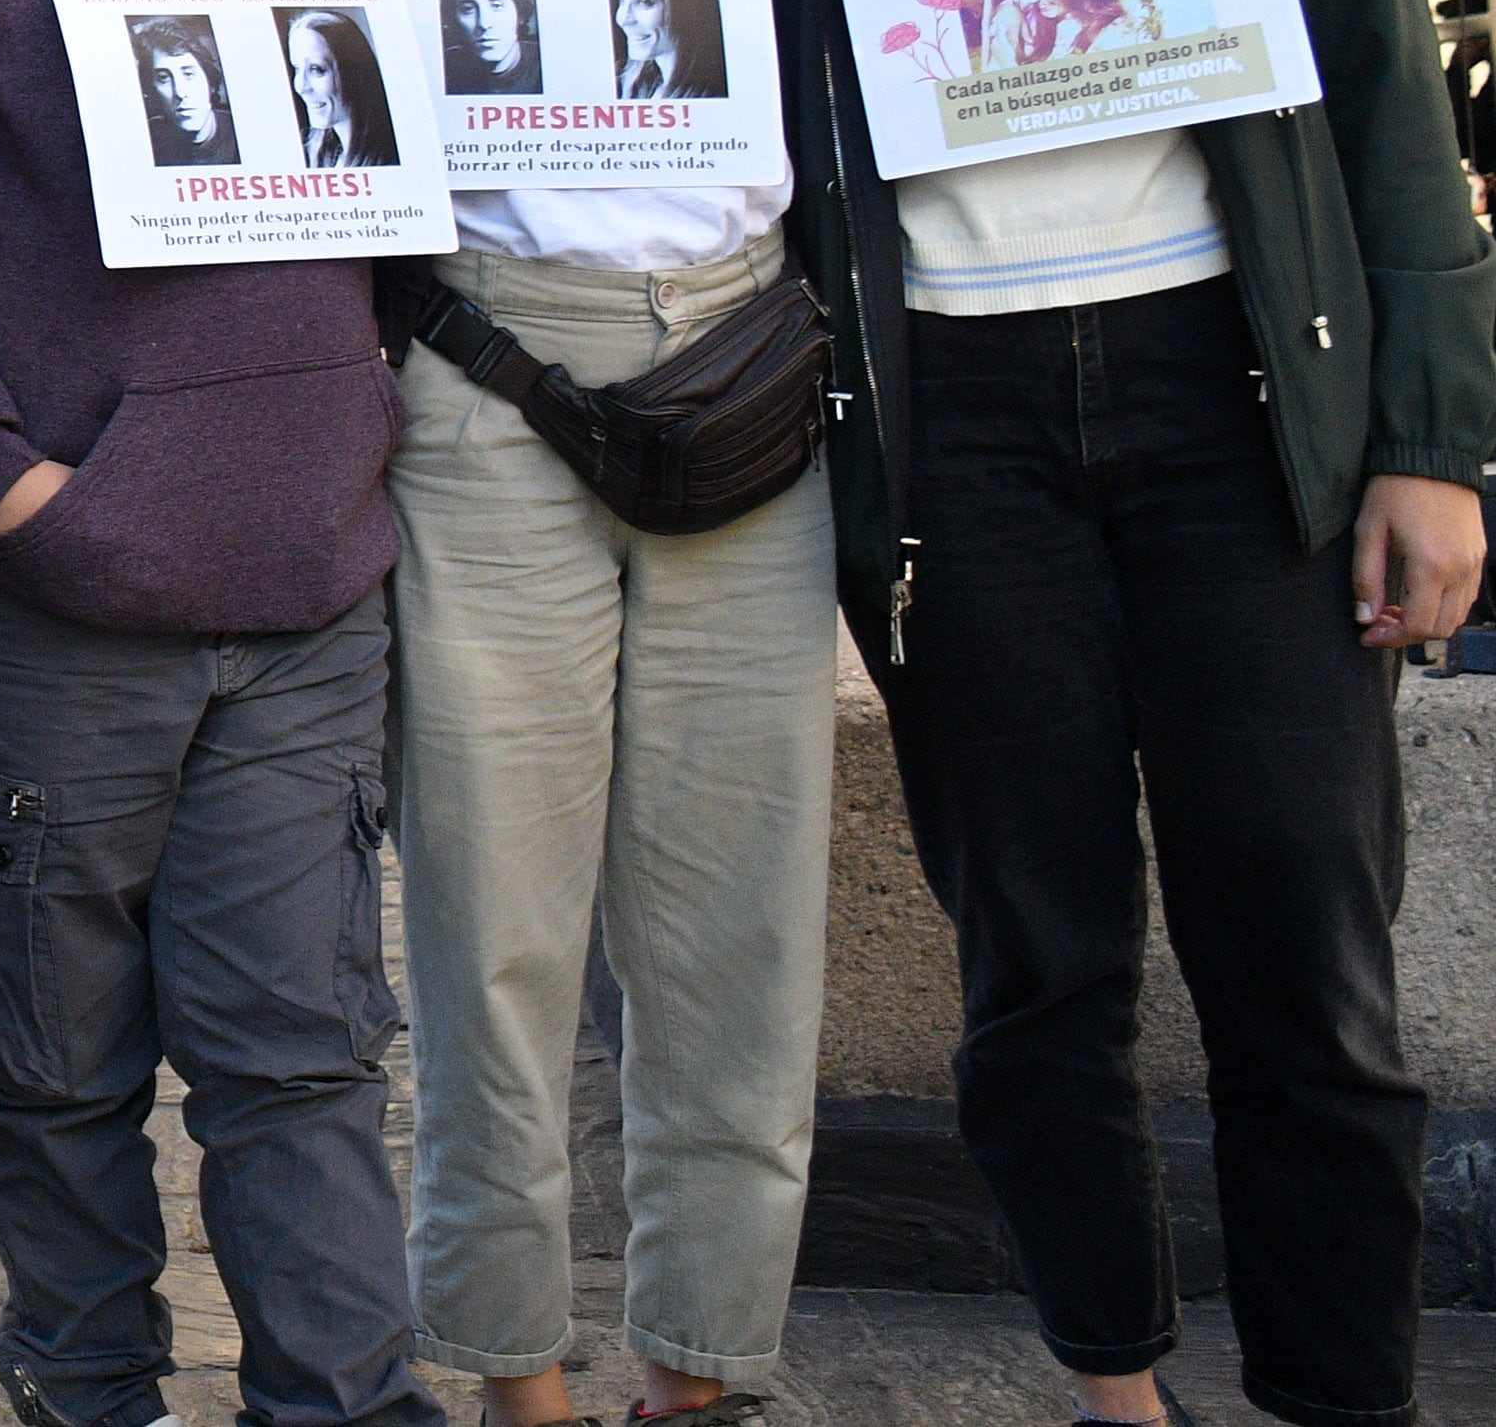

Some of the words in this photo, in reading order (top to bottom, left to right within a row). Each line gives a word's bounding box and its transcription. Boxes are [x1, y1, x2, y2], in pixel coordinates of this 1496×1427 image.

[946, 81, 994, 100] Cada
[998, 65, 1083, 91] hallazgo
[1089, 60, 1109, 73] es
[1115, 54, 1140, 69] un
[1146, 45, 1192, 67] paso
[1198, 33, 1239, 54] más
[957, 105, 980, 120] en
[986, 100, 1003, 115] la
[1008, 82, 1104, 111] búsqueda
[1109, 76, 1132, 92] de
[1137, 56, 1244, 87] MEMORIA,
[466, 105, 691, 130] ¡PRESENTES!
[1006, 105, 1085, 133] VERDAD
[1088, 102, 1103, 118] Y
[1105, 86, 1200, 116] JUSTICIA.
[444, 141, 479, 157] gún
[487, 140, 543, 157] poder
[550, 138, 693, 155] desaparecedor
[700, 137, 748, 154] pudo
[447, 159, 510, 172] borrar
[517, 158, 533, 171] el
[540, 161, 594, 171] surco
[601, 157, 623, 170] de
[630, 160, 660, 170] sus
[667, 157, 715, 170] vidas
[175, 172, 372, 202] ¡PRESENTES!
[130, 213, 192, 231] Ningún
[198, 211, 248, 229] poder
[254, 207, 377, 226] desaparecedor
[382, 205, 424, 222] pudo
[165, 233, 221, 246] borrar
[228, 230, 242, 243] el
[248, 231, 295, 243] surco
[301, 227, 320, 241] de
[325, 228, 352, 239] sus
[357, 225, 399, 238] vidas
